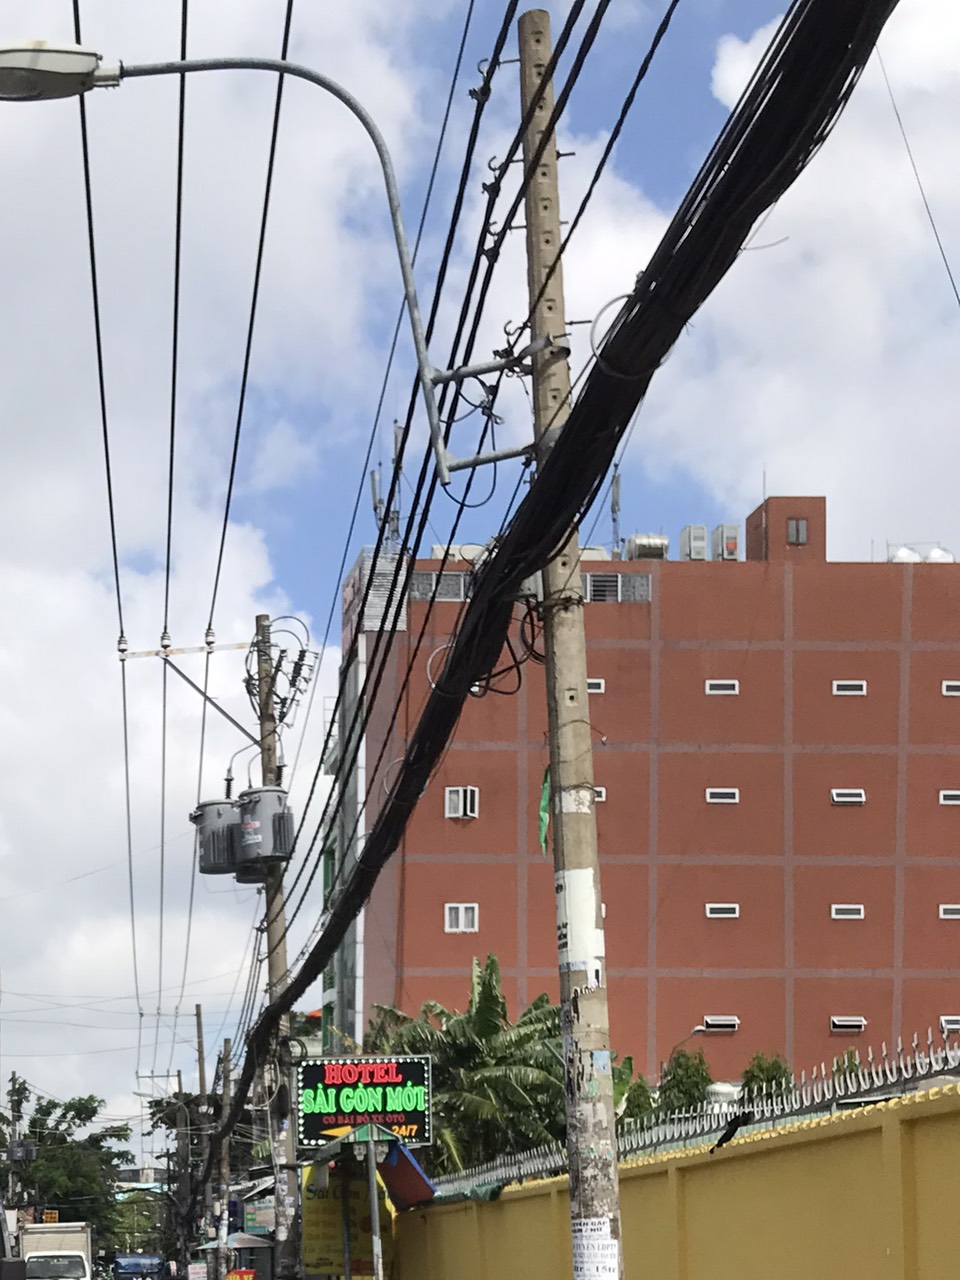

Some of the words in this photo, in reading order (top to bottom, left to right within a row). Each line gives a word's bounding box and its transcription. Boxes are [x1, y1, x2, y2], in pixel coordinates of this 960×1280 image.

[323, 1062, 402, 1084] HOTEL
[302, 1083, 336, 1113] SÀI
[340, 1082, 383, 1113] GÒN
[386, 1080, 426, 1112] MỚI
[391, 1125, 418, 1137] 24/7
